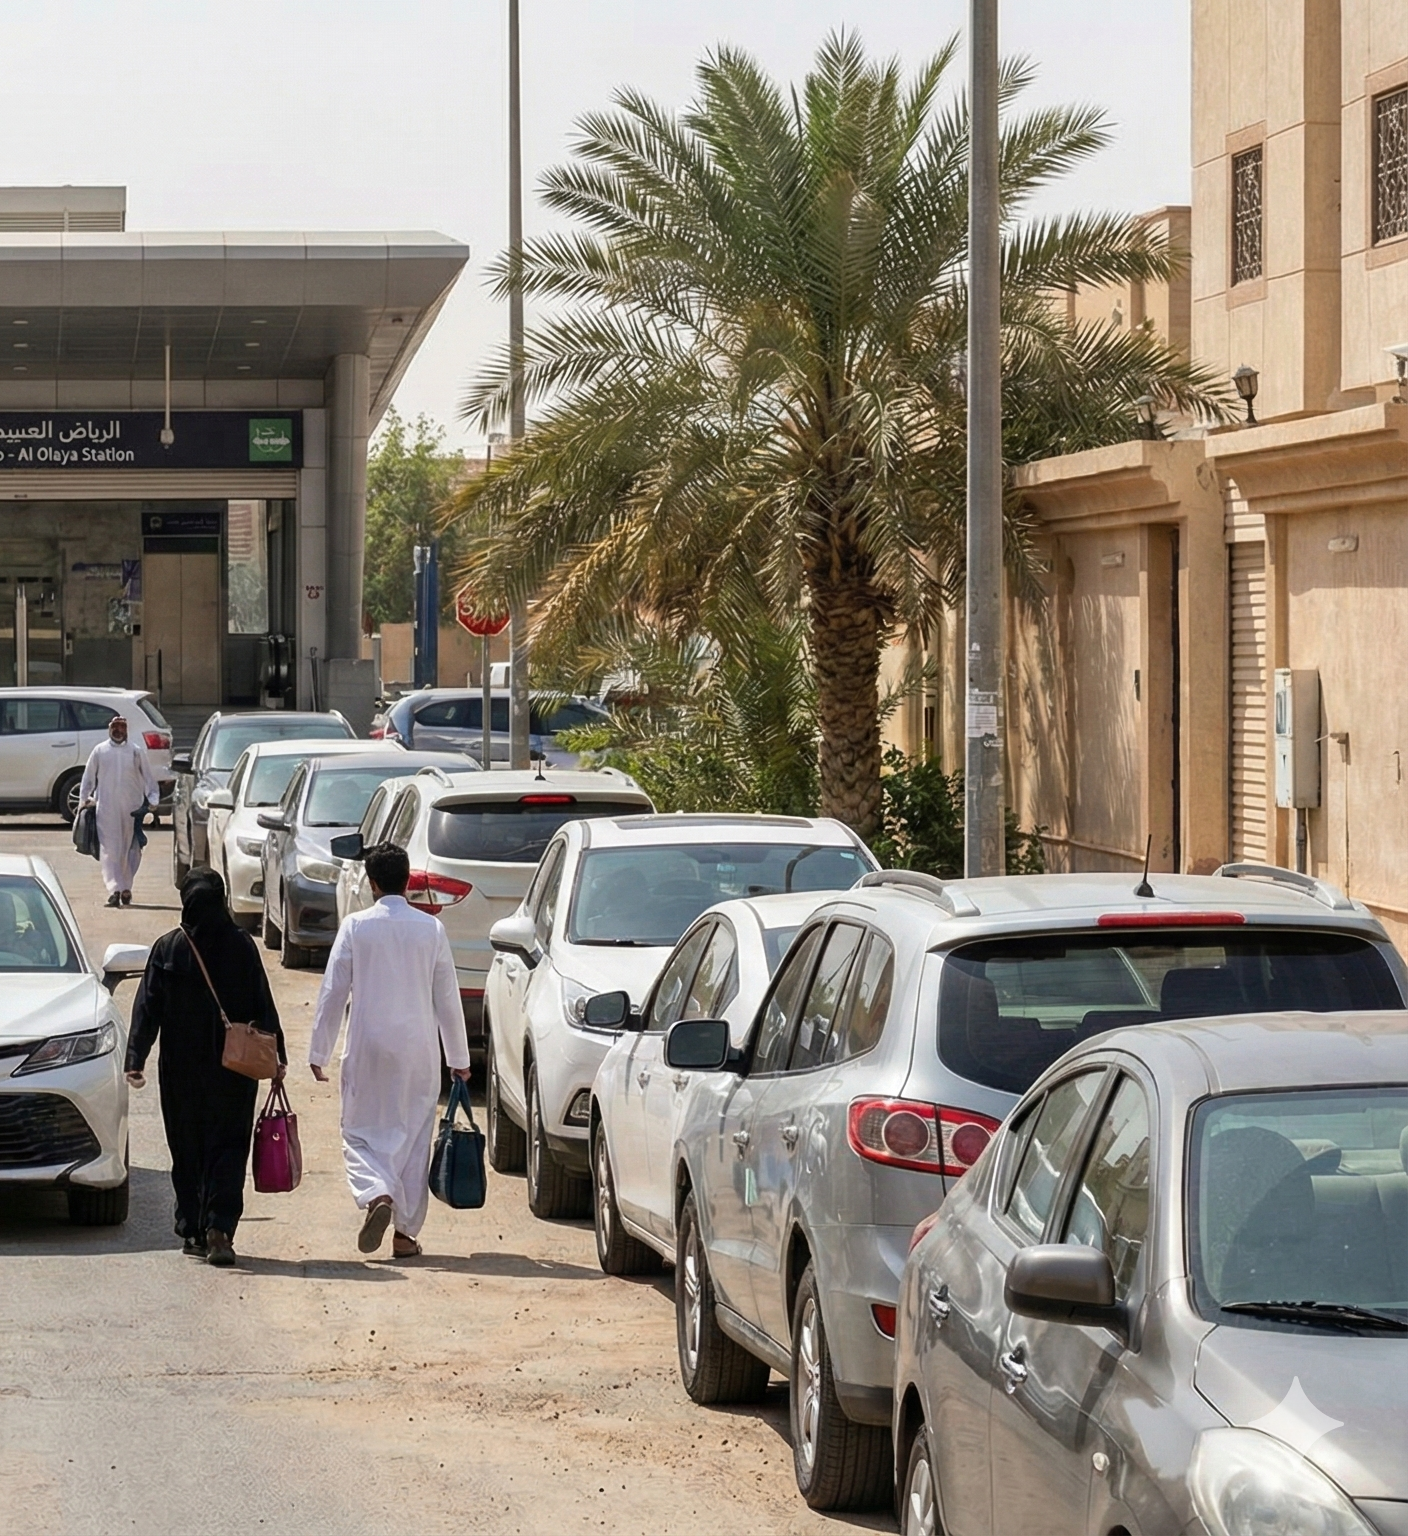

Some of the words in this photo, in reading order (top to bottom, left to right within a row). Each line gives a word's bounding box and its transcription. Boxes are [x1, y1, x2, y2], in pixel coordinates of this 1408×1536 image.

[59, 420, 120, 443] الرياض
[18, 447, 33, 461] Al
[36, 447, 78, 465] Olaya
[82, 447, 135, 462] Station
